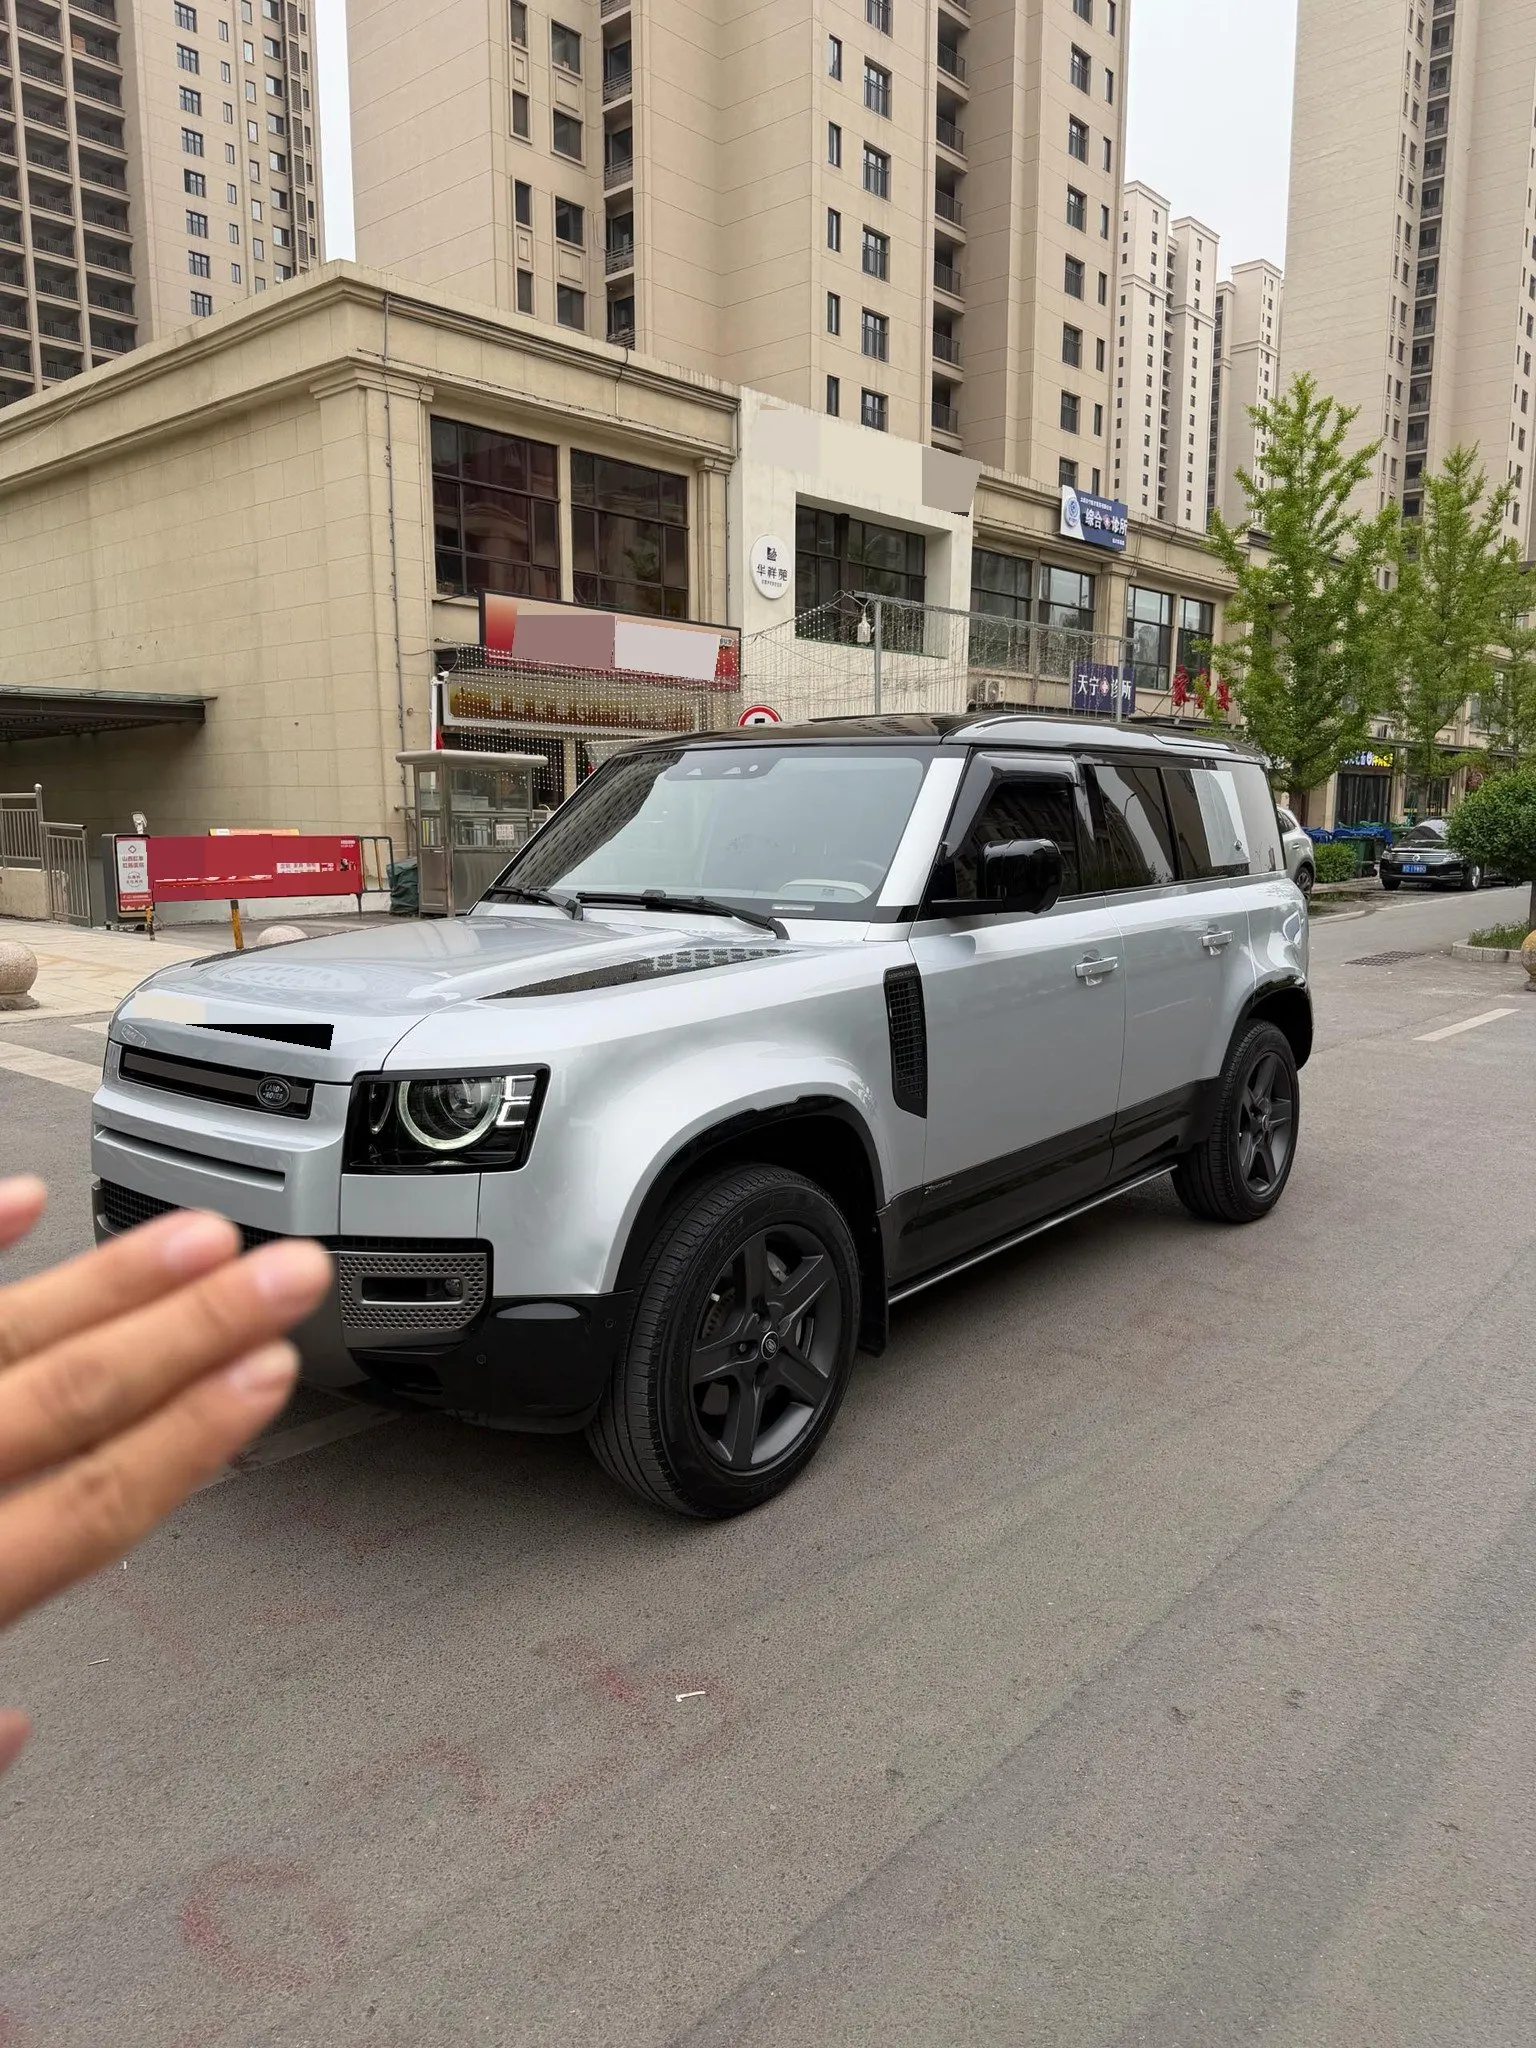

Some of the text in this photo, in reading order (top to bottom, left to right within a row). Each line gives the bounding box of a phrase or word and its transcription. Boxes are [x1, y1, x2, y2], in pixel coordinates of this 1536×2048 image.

[756, 563, 788, 582] 华祥苑
[1077, 674, 1132, 700] 天宁诊所
[265, 1084, 280, 1093] LAND
[265, 1092, 283, 1100] ROVER
